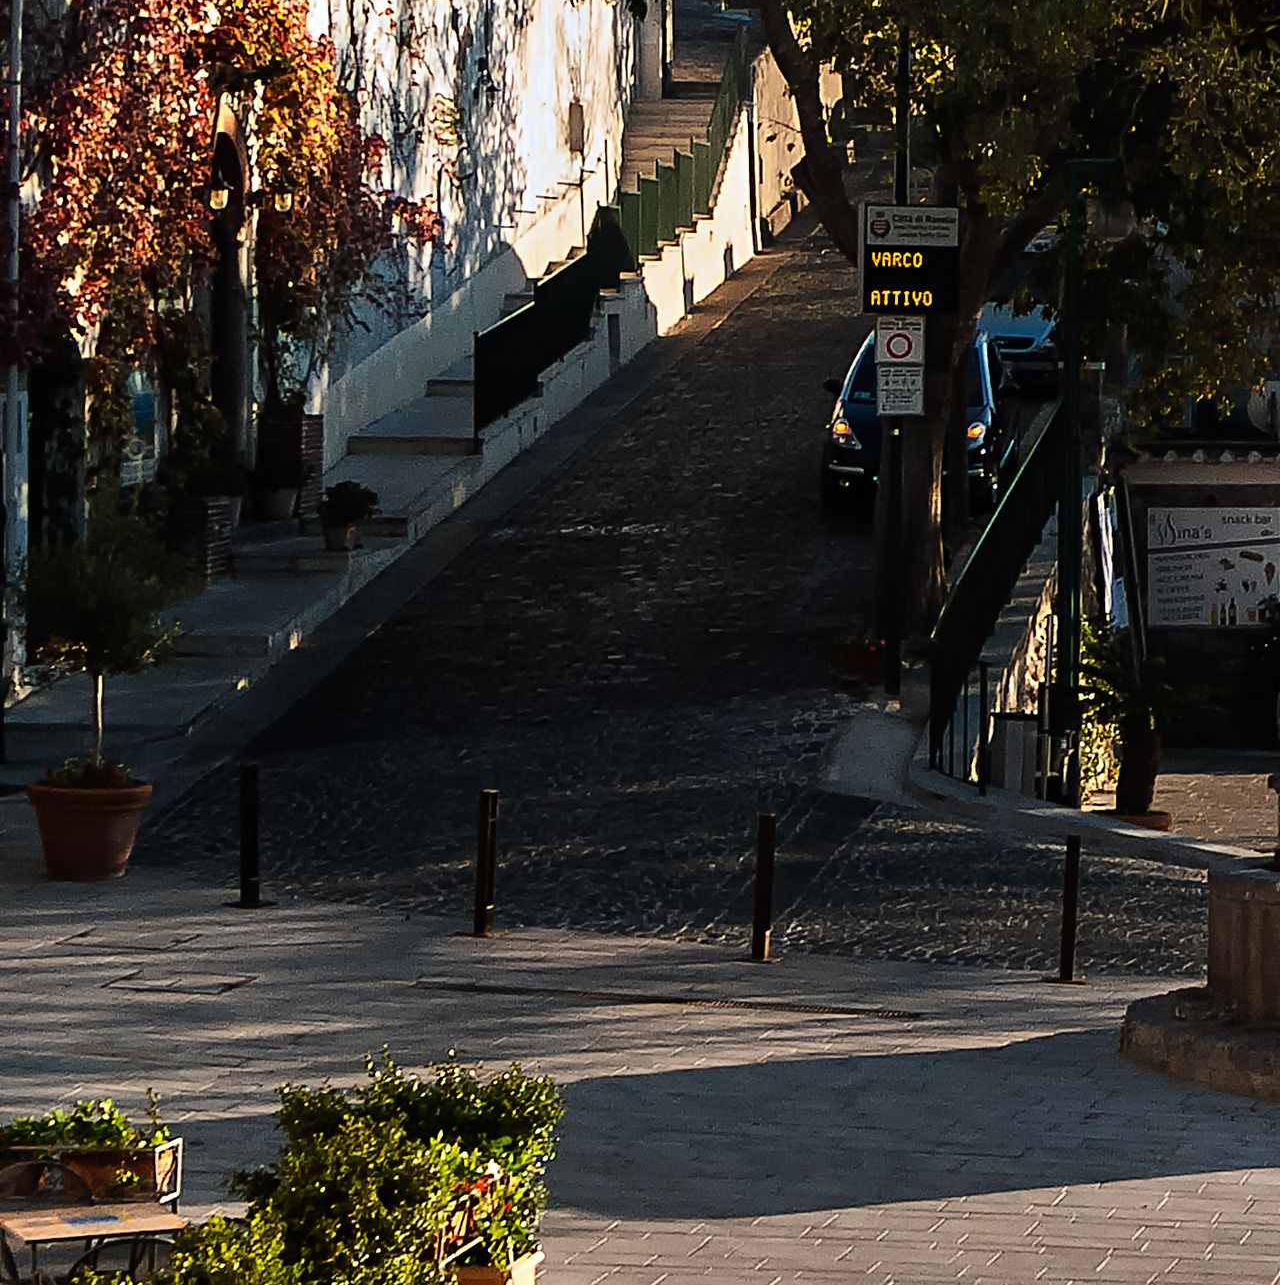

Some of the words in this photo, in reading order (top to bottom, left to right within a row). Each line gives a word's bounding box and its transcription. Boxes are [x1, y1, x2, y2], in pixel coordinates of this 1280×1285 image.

[871, 252, 923, 268] VARCO
[870, 290, 933, 306] ATTIVO
[1221, 514, 1252, 525] snack
[1254, 514, 1272, 524] bar
